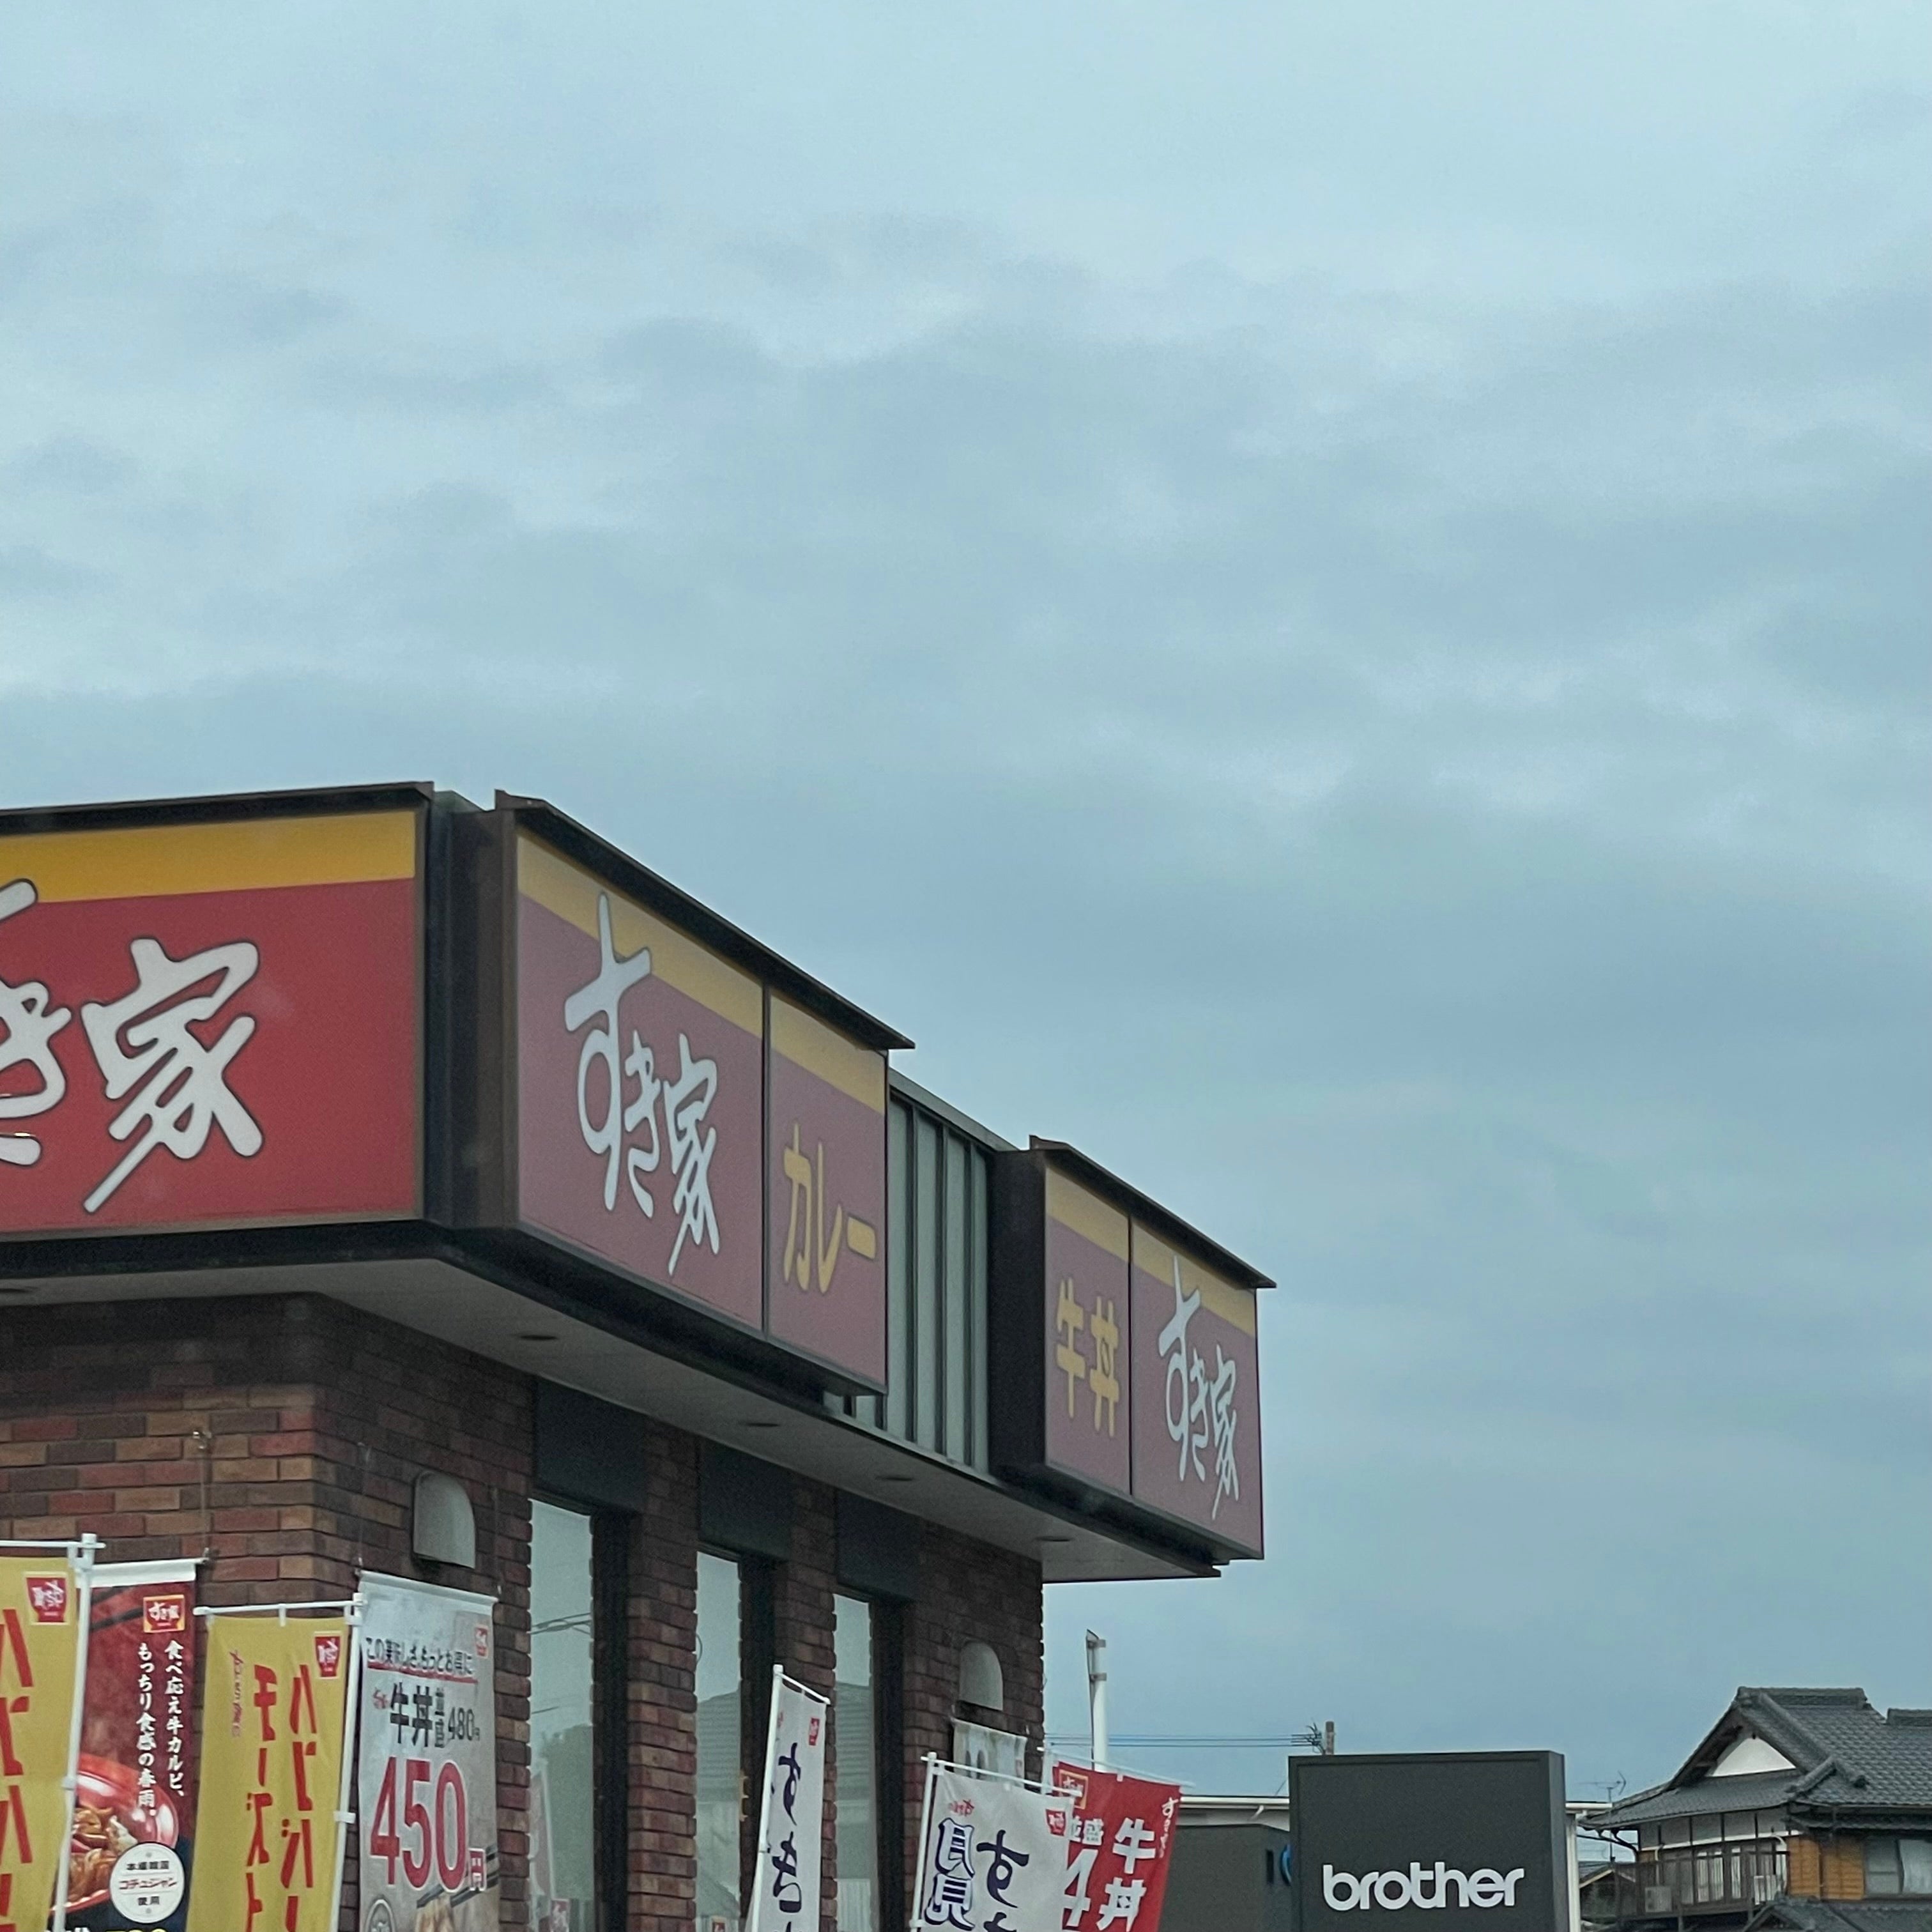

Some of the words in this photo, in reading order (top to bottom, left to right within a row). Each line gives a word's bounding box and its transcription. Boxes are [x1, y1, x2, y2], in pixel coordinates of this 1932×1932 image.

[0, 878, 263, 1213] き家
[565, 892, 720, 1276] すき家
[783, 1120, 876, 1294] カレー
[1055, 1276, 1120, 1438] 牛丼
[1158, 1254, 1239, 1521] すき家
[1096, 1817, 1156, 1932] 牛丼
[1322, 1862, 1524, 1911] brother
